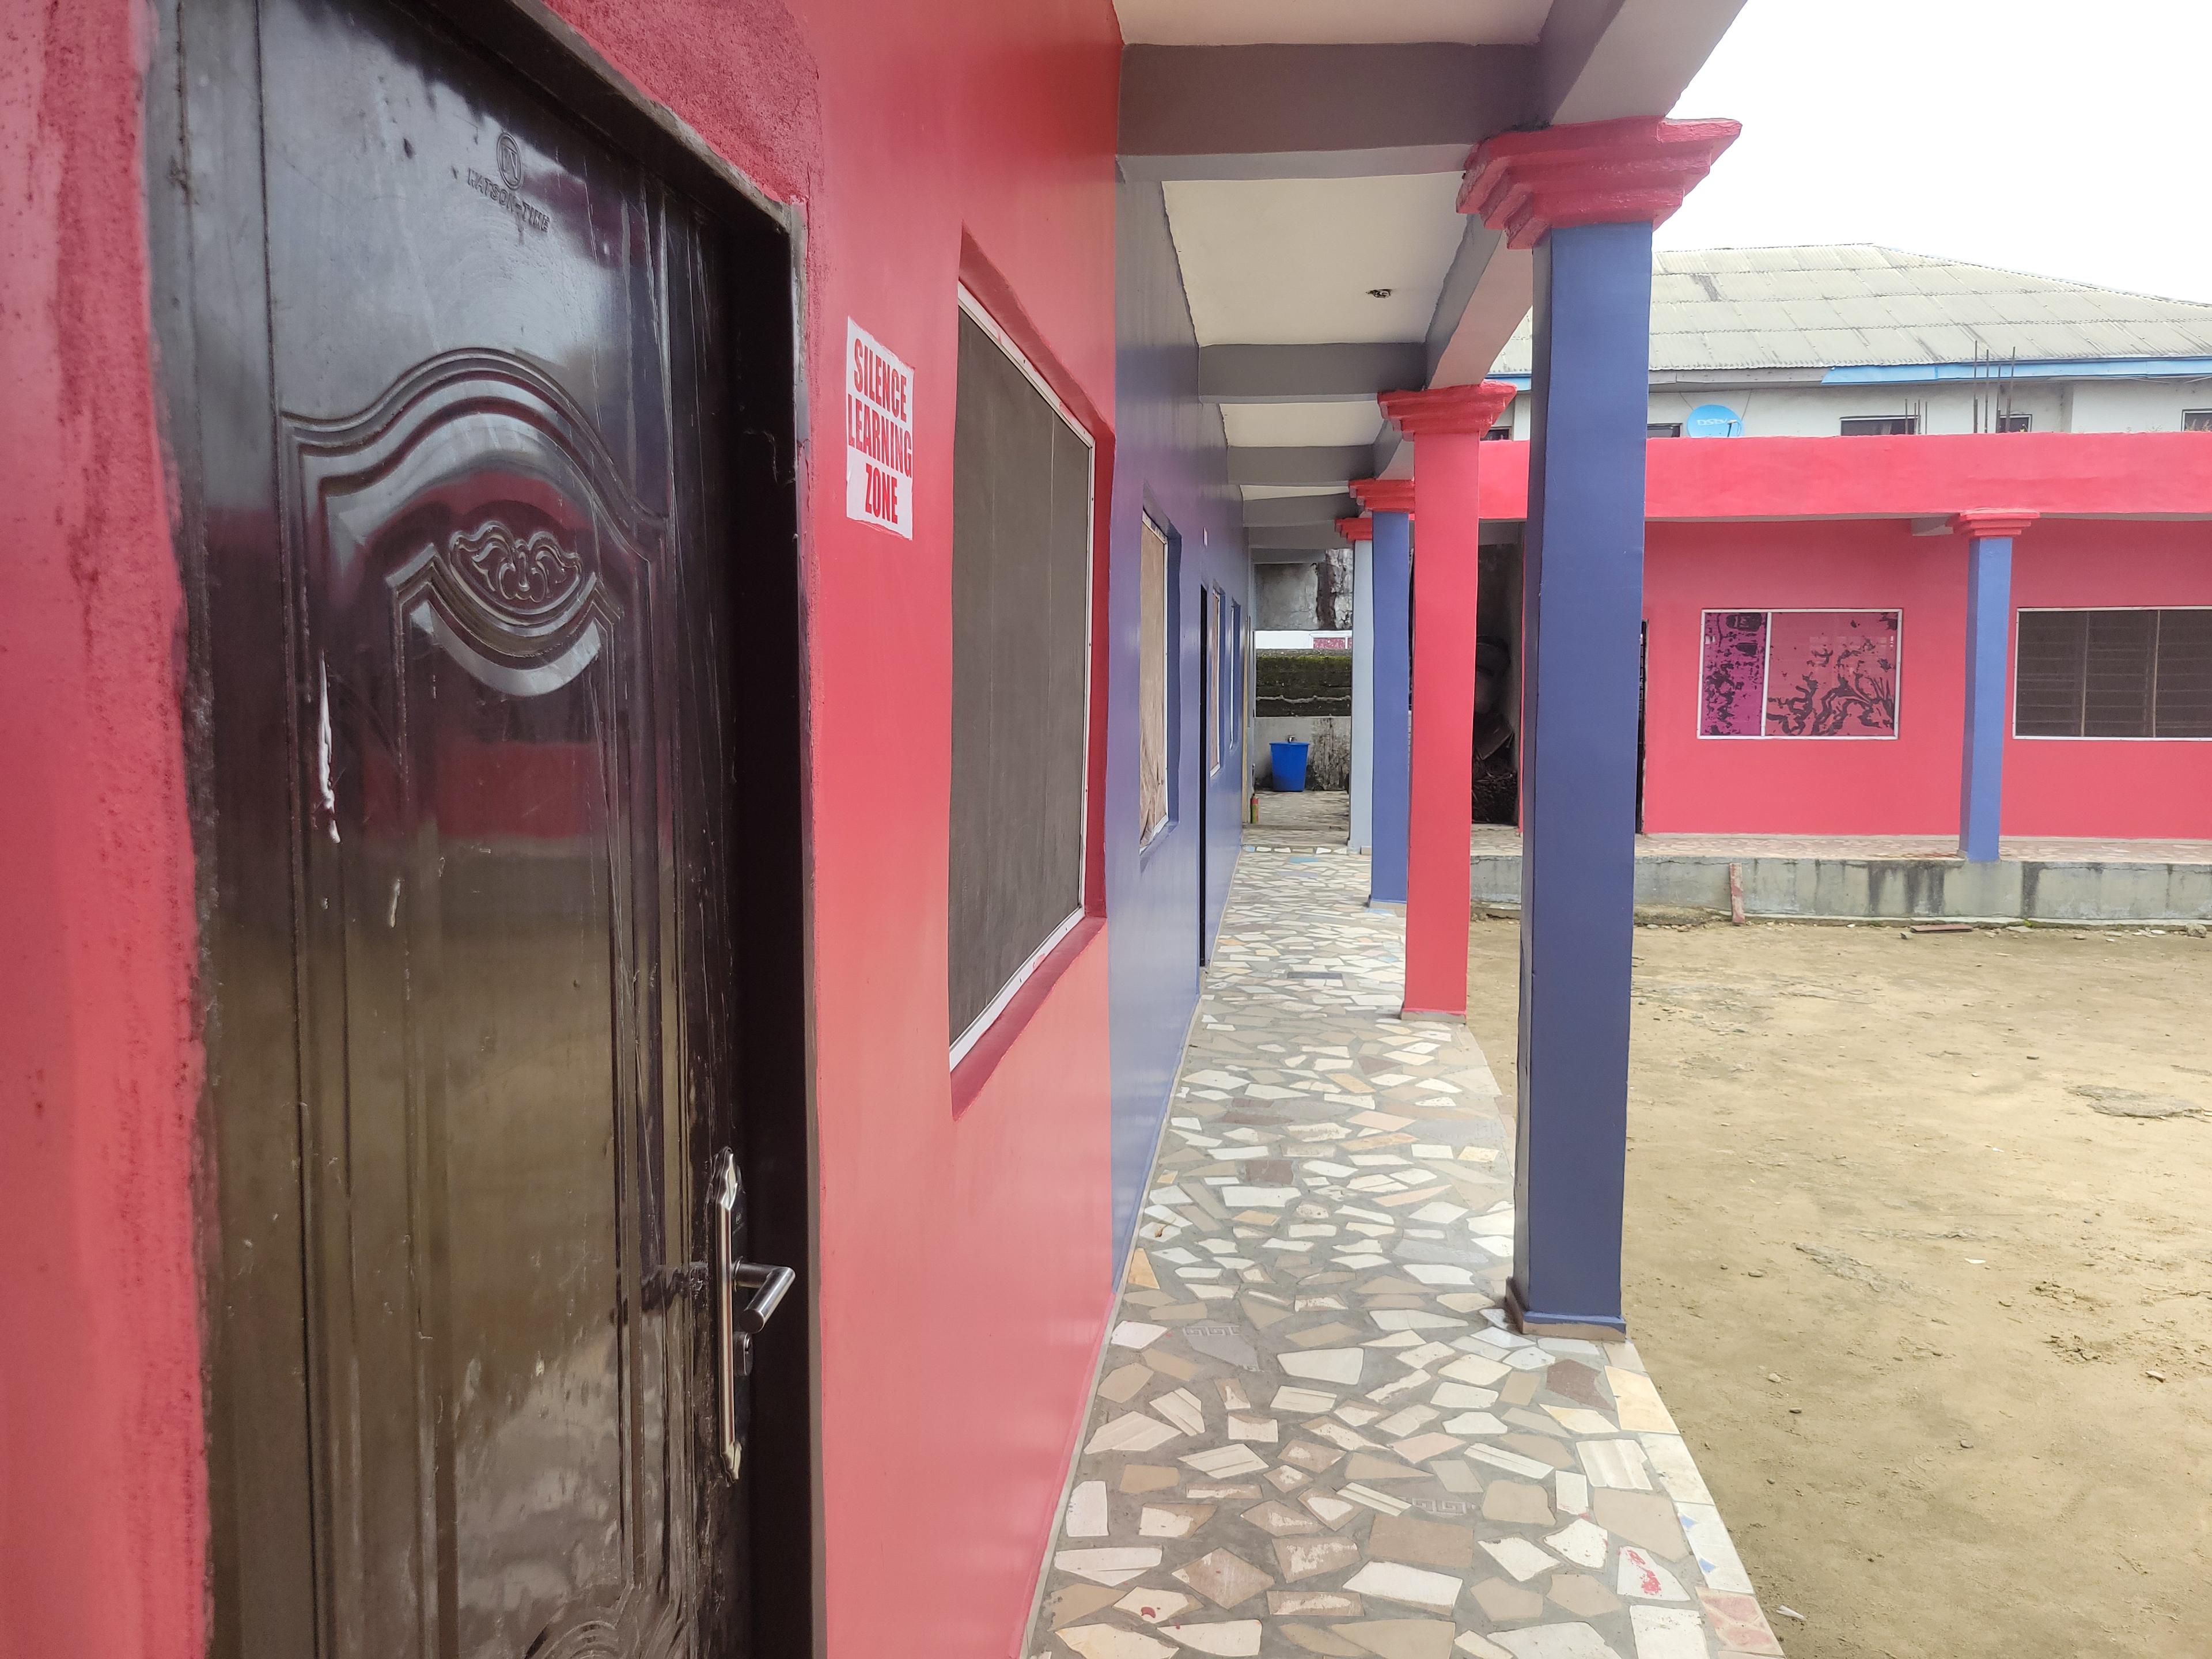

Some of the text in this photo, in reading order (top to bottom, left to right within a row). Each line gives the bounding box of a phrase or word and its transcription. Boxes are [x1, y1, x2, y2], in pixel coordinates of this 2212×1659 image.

[854, 338, 907, 422] SILENCE
[848, 393, 912, 478] LEARNING
[865, 463, 898, 524] ZONE
